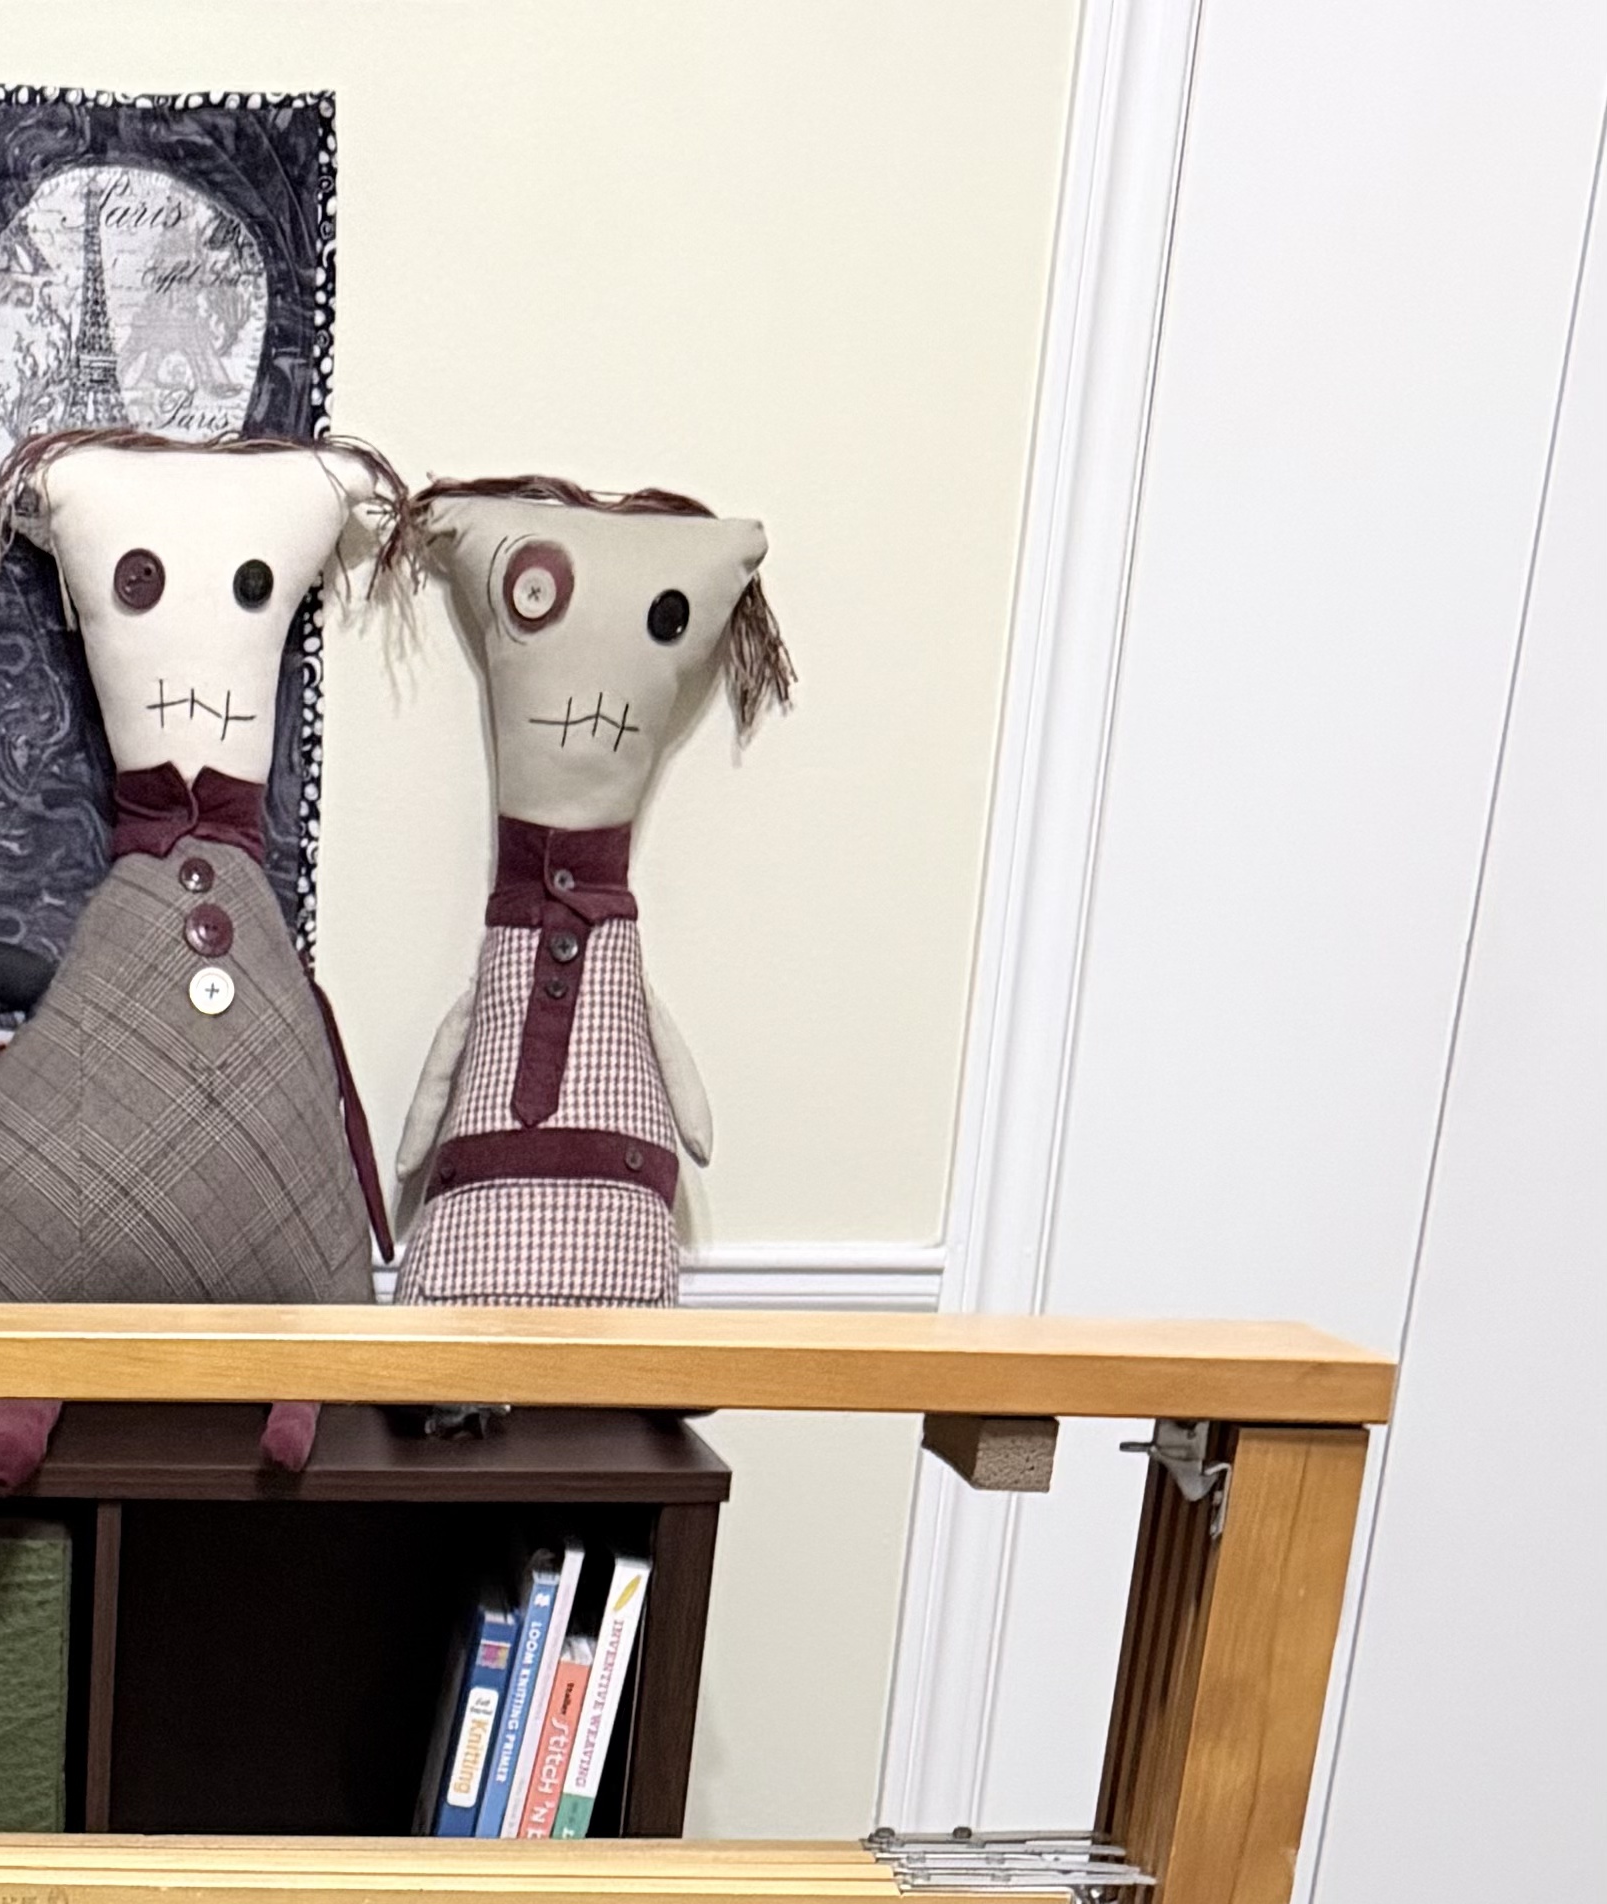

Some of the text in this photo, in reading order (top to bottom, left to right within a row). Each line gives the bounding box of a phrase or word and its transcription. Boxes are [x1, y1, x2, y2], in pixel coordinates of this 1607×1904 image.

[62, 175, 182, 229] Paris
[148, 388, 229, 432] Paris
[525, 1621, 542, 1665] LOOM
[509, 1668, 530, 1730] KNITTING
[575, 1619, 624, 1788] INVENTIVE WEAVING
[453, 1718, 488, 1794] Knitting
[496, 1732, 517, 1783] PRIMER
